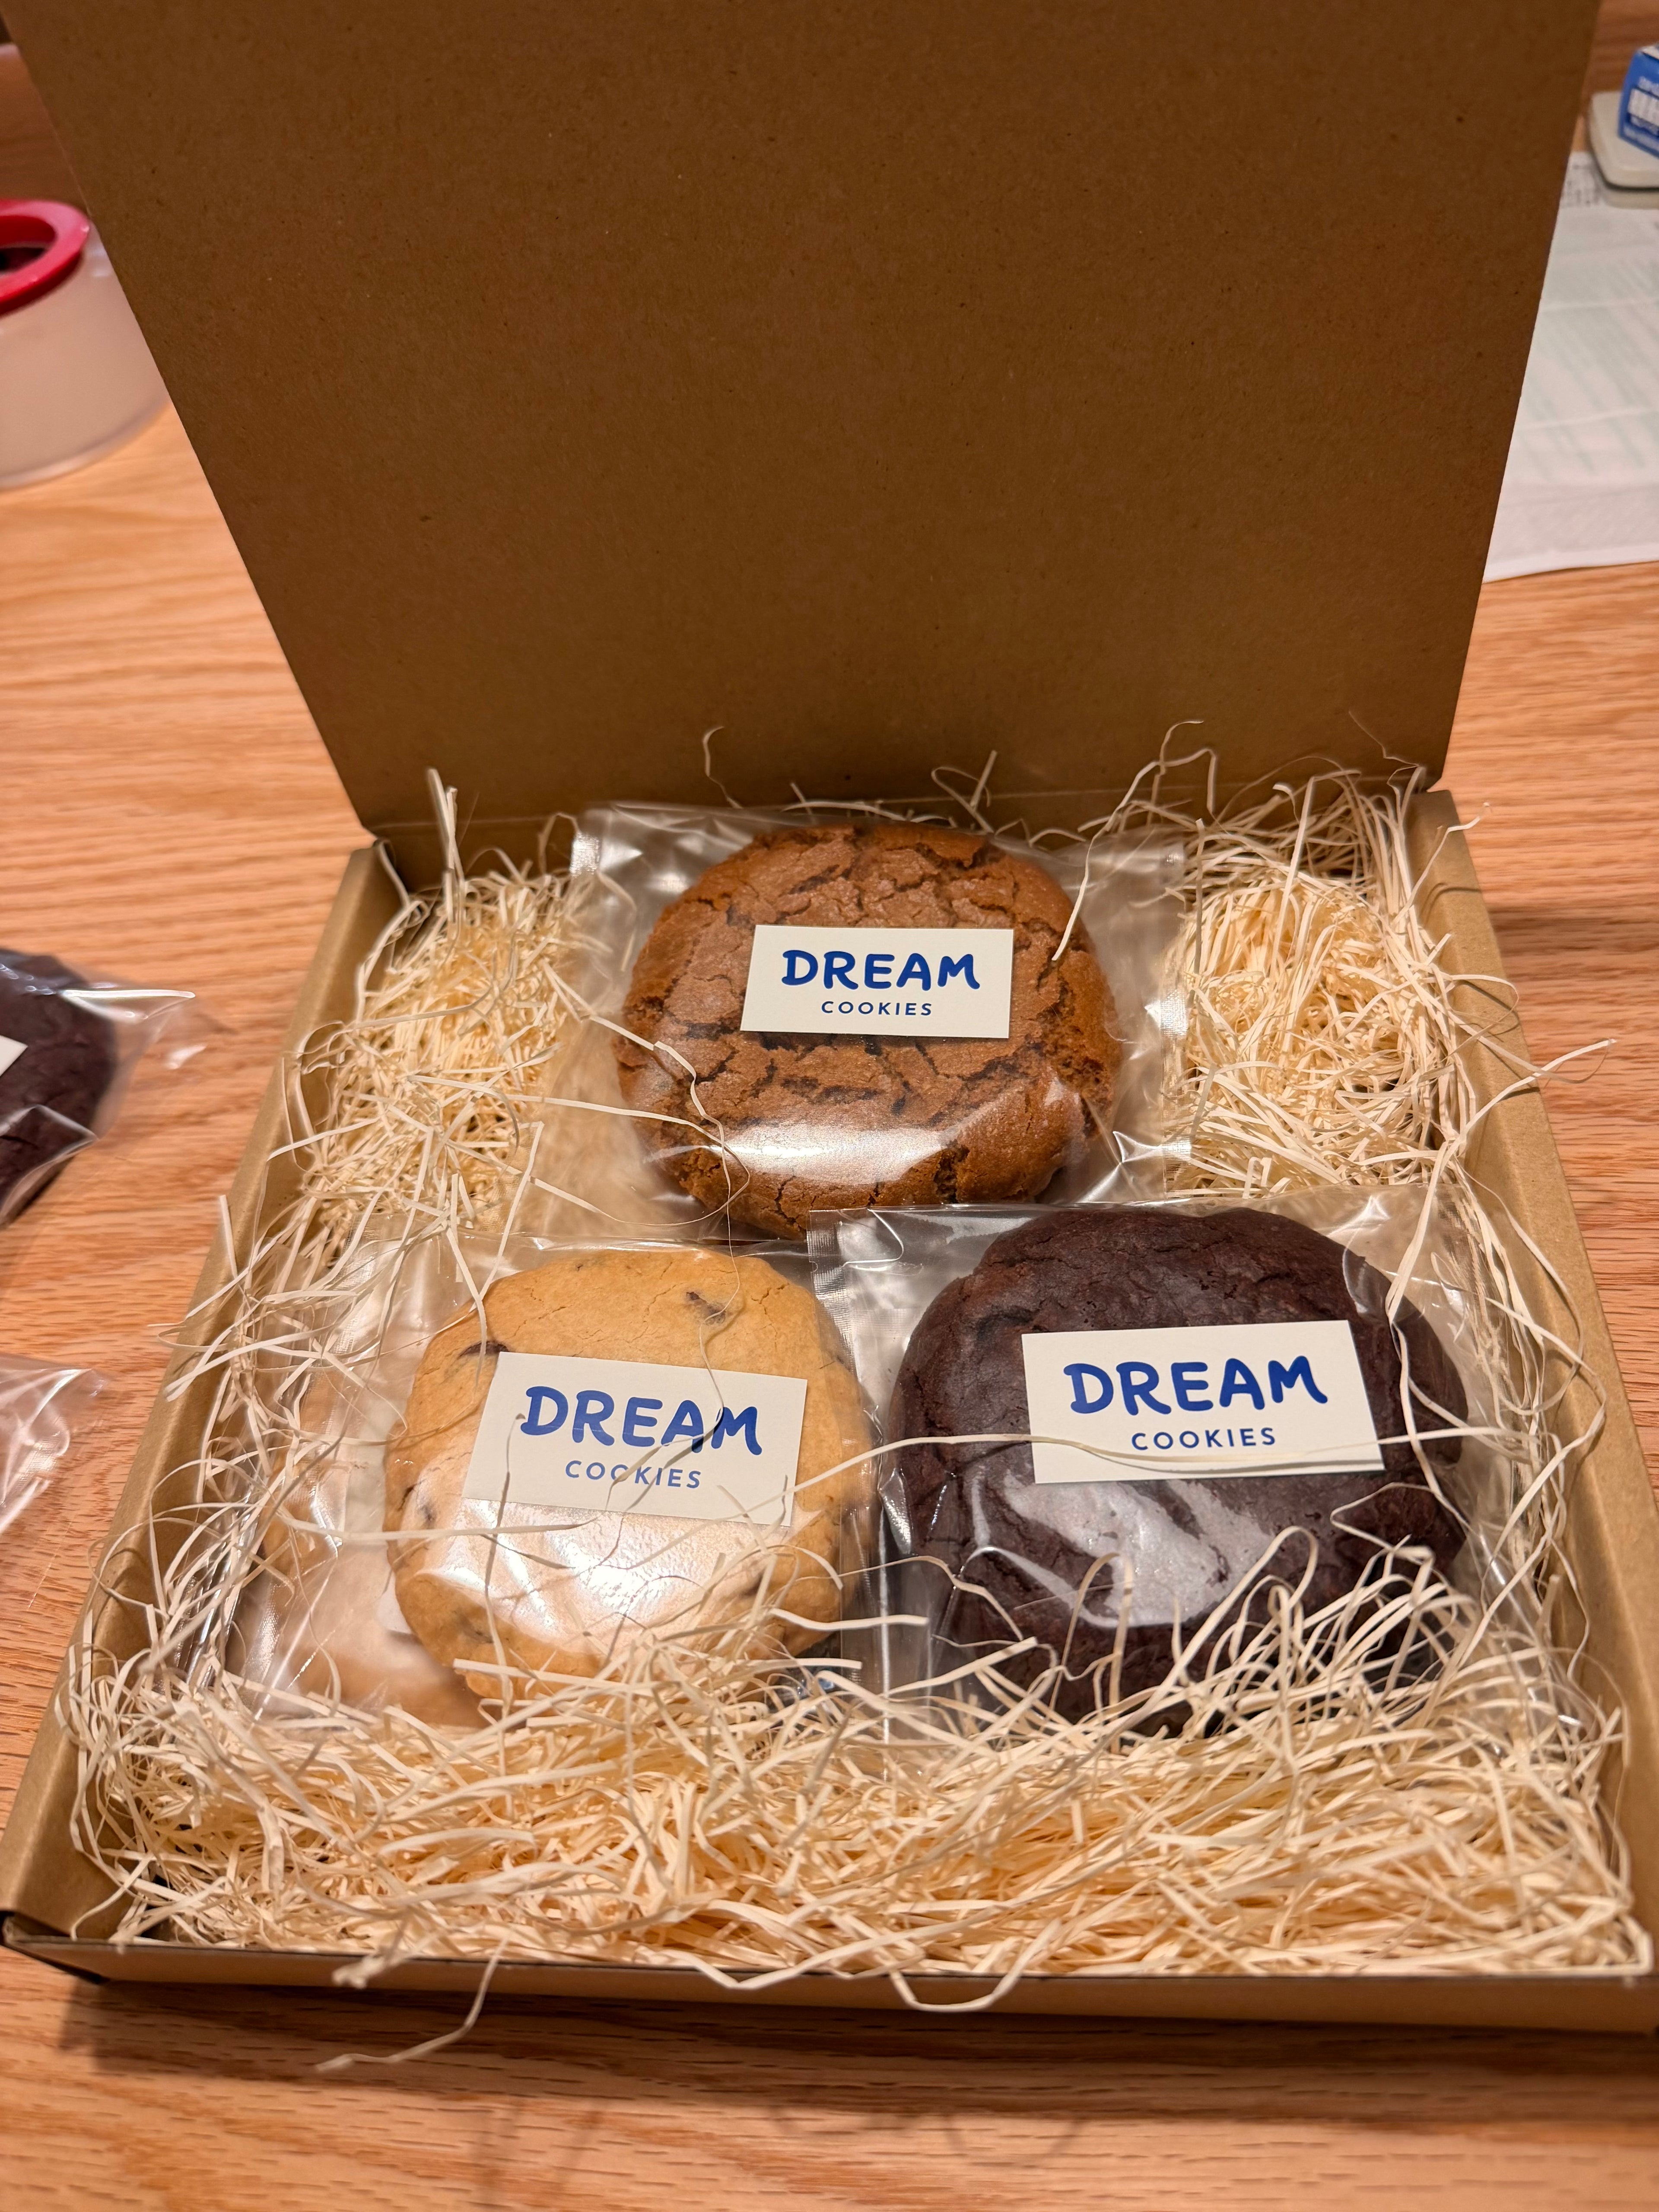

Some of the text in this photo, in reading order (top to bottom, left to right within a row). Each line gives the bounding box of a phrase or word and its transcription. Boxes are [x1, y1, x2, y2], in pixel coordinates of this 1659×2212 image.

[781, 950, 980, 991] DREAM
[821, 1001, 932, 1016] COOKIES
[1063, 1355, 1328, 1416] DREAM
[520, 1386, 763, 1456] DREAM
[1131, 1427, 1276, 1451] COOKIES
